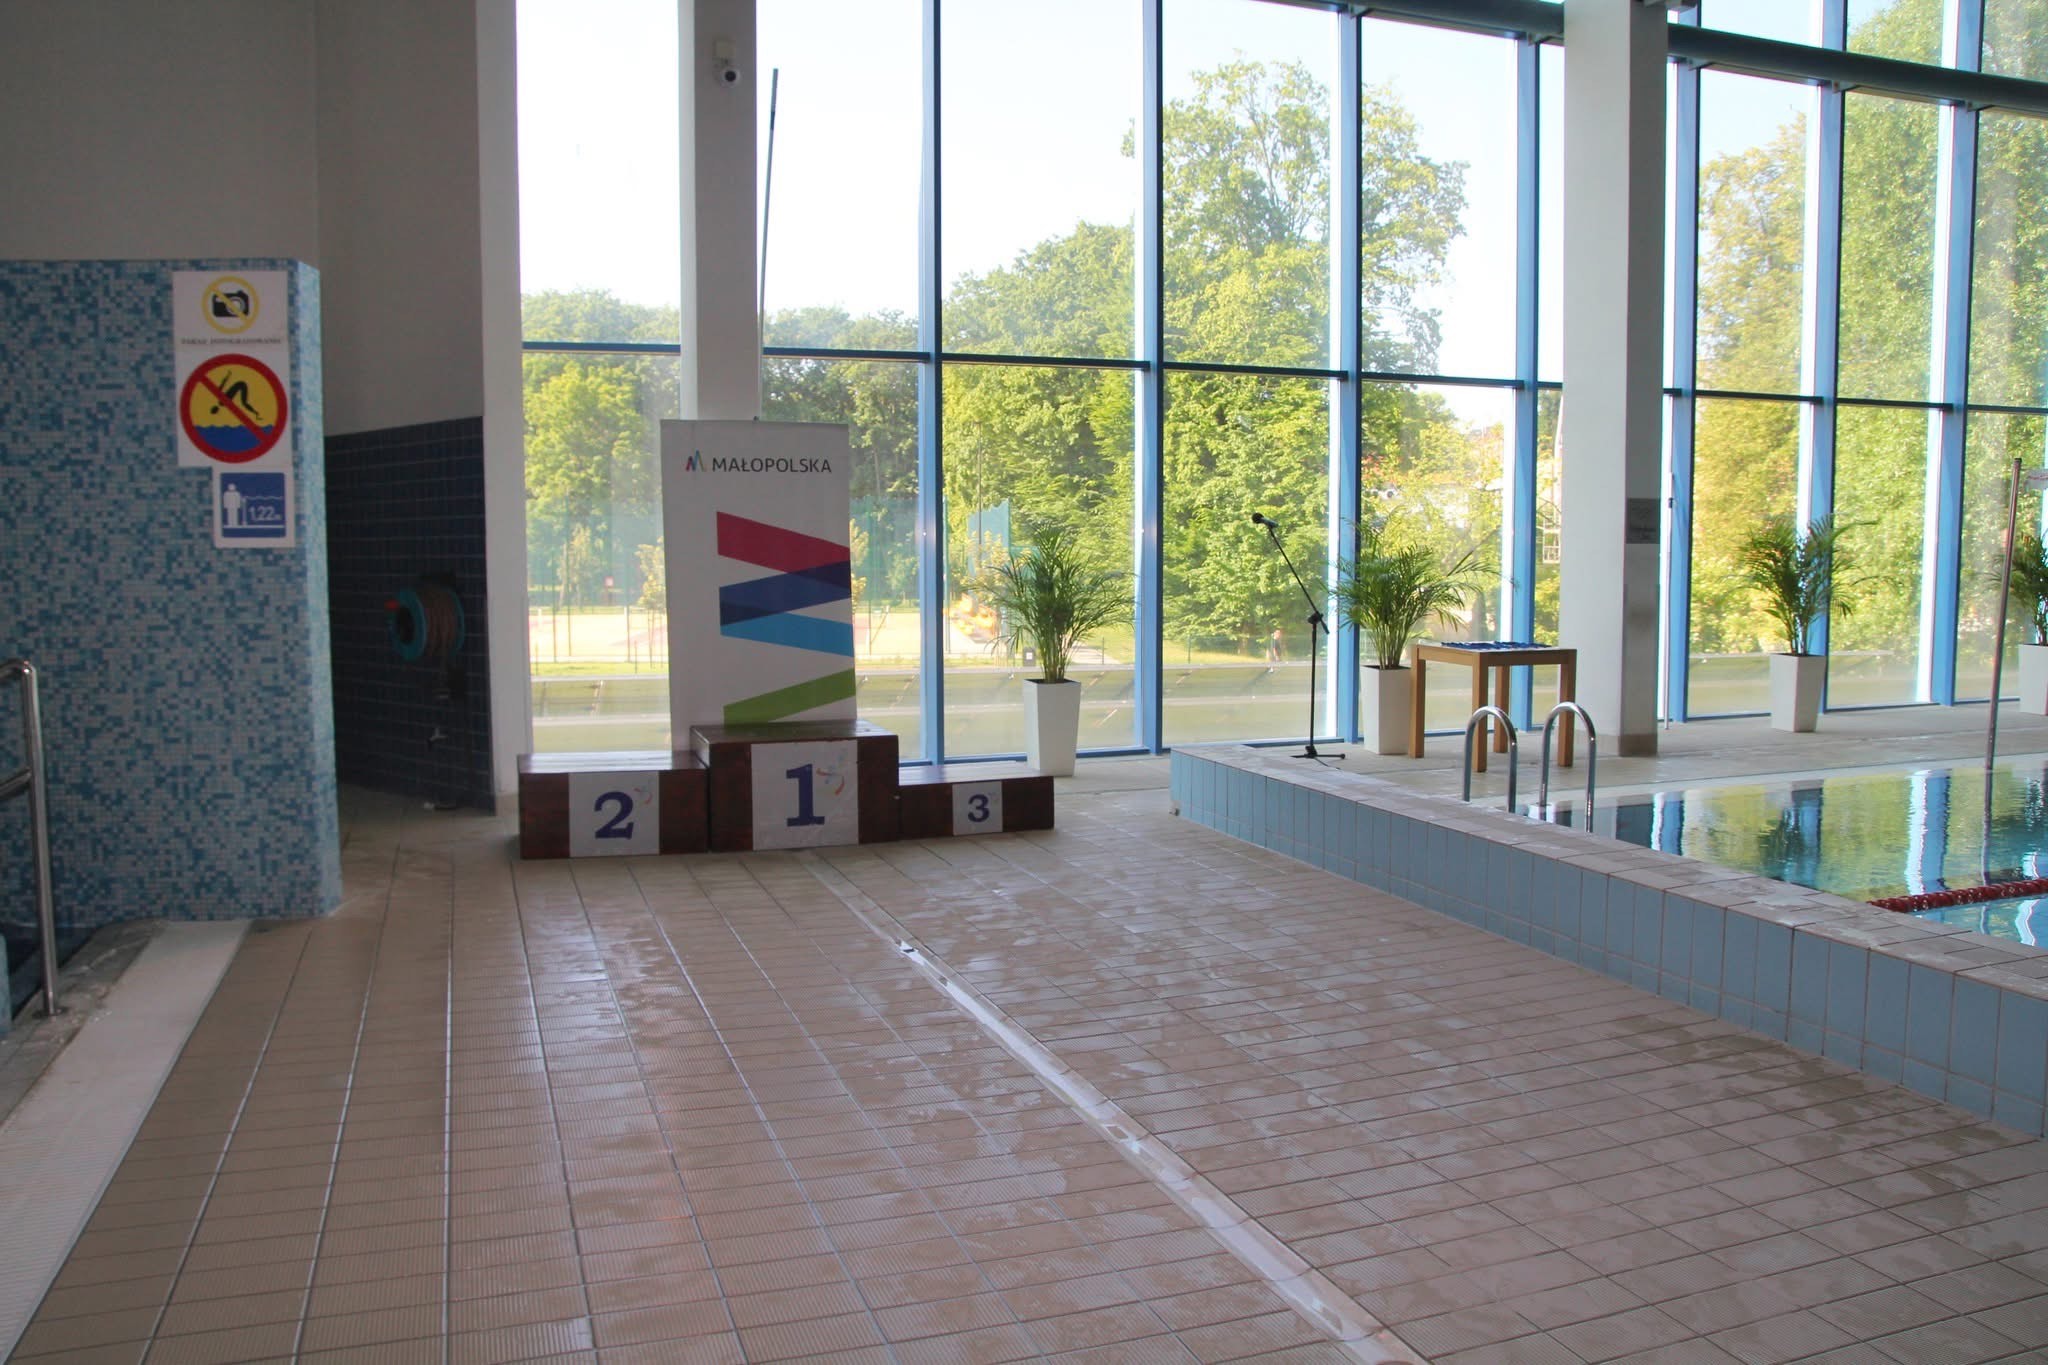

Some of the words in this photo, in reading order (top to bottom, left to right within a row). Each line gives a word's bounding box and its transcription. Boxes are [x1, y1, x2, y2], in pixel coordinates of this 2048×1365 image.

[712, 457, 832, 473] MAŁOPOLSKA
[593, 790, 635, 841] 2
[785, 763, 826, 828] 1
[966, 793, 990, 823] 3
